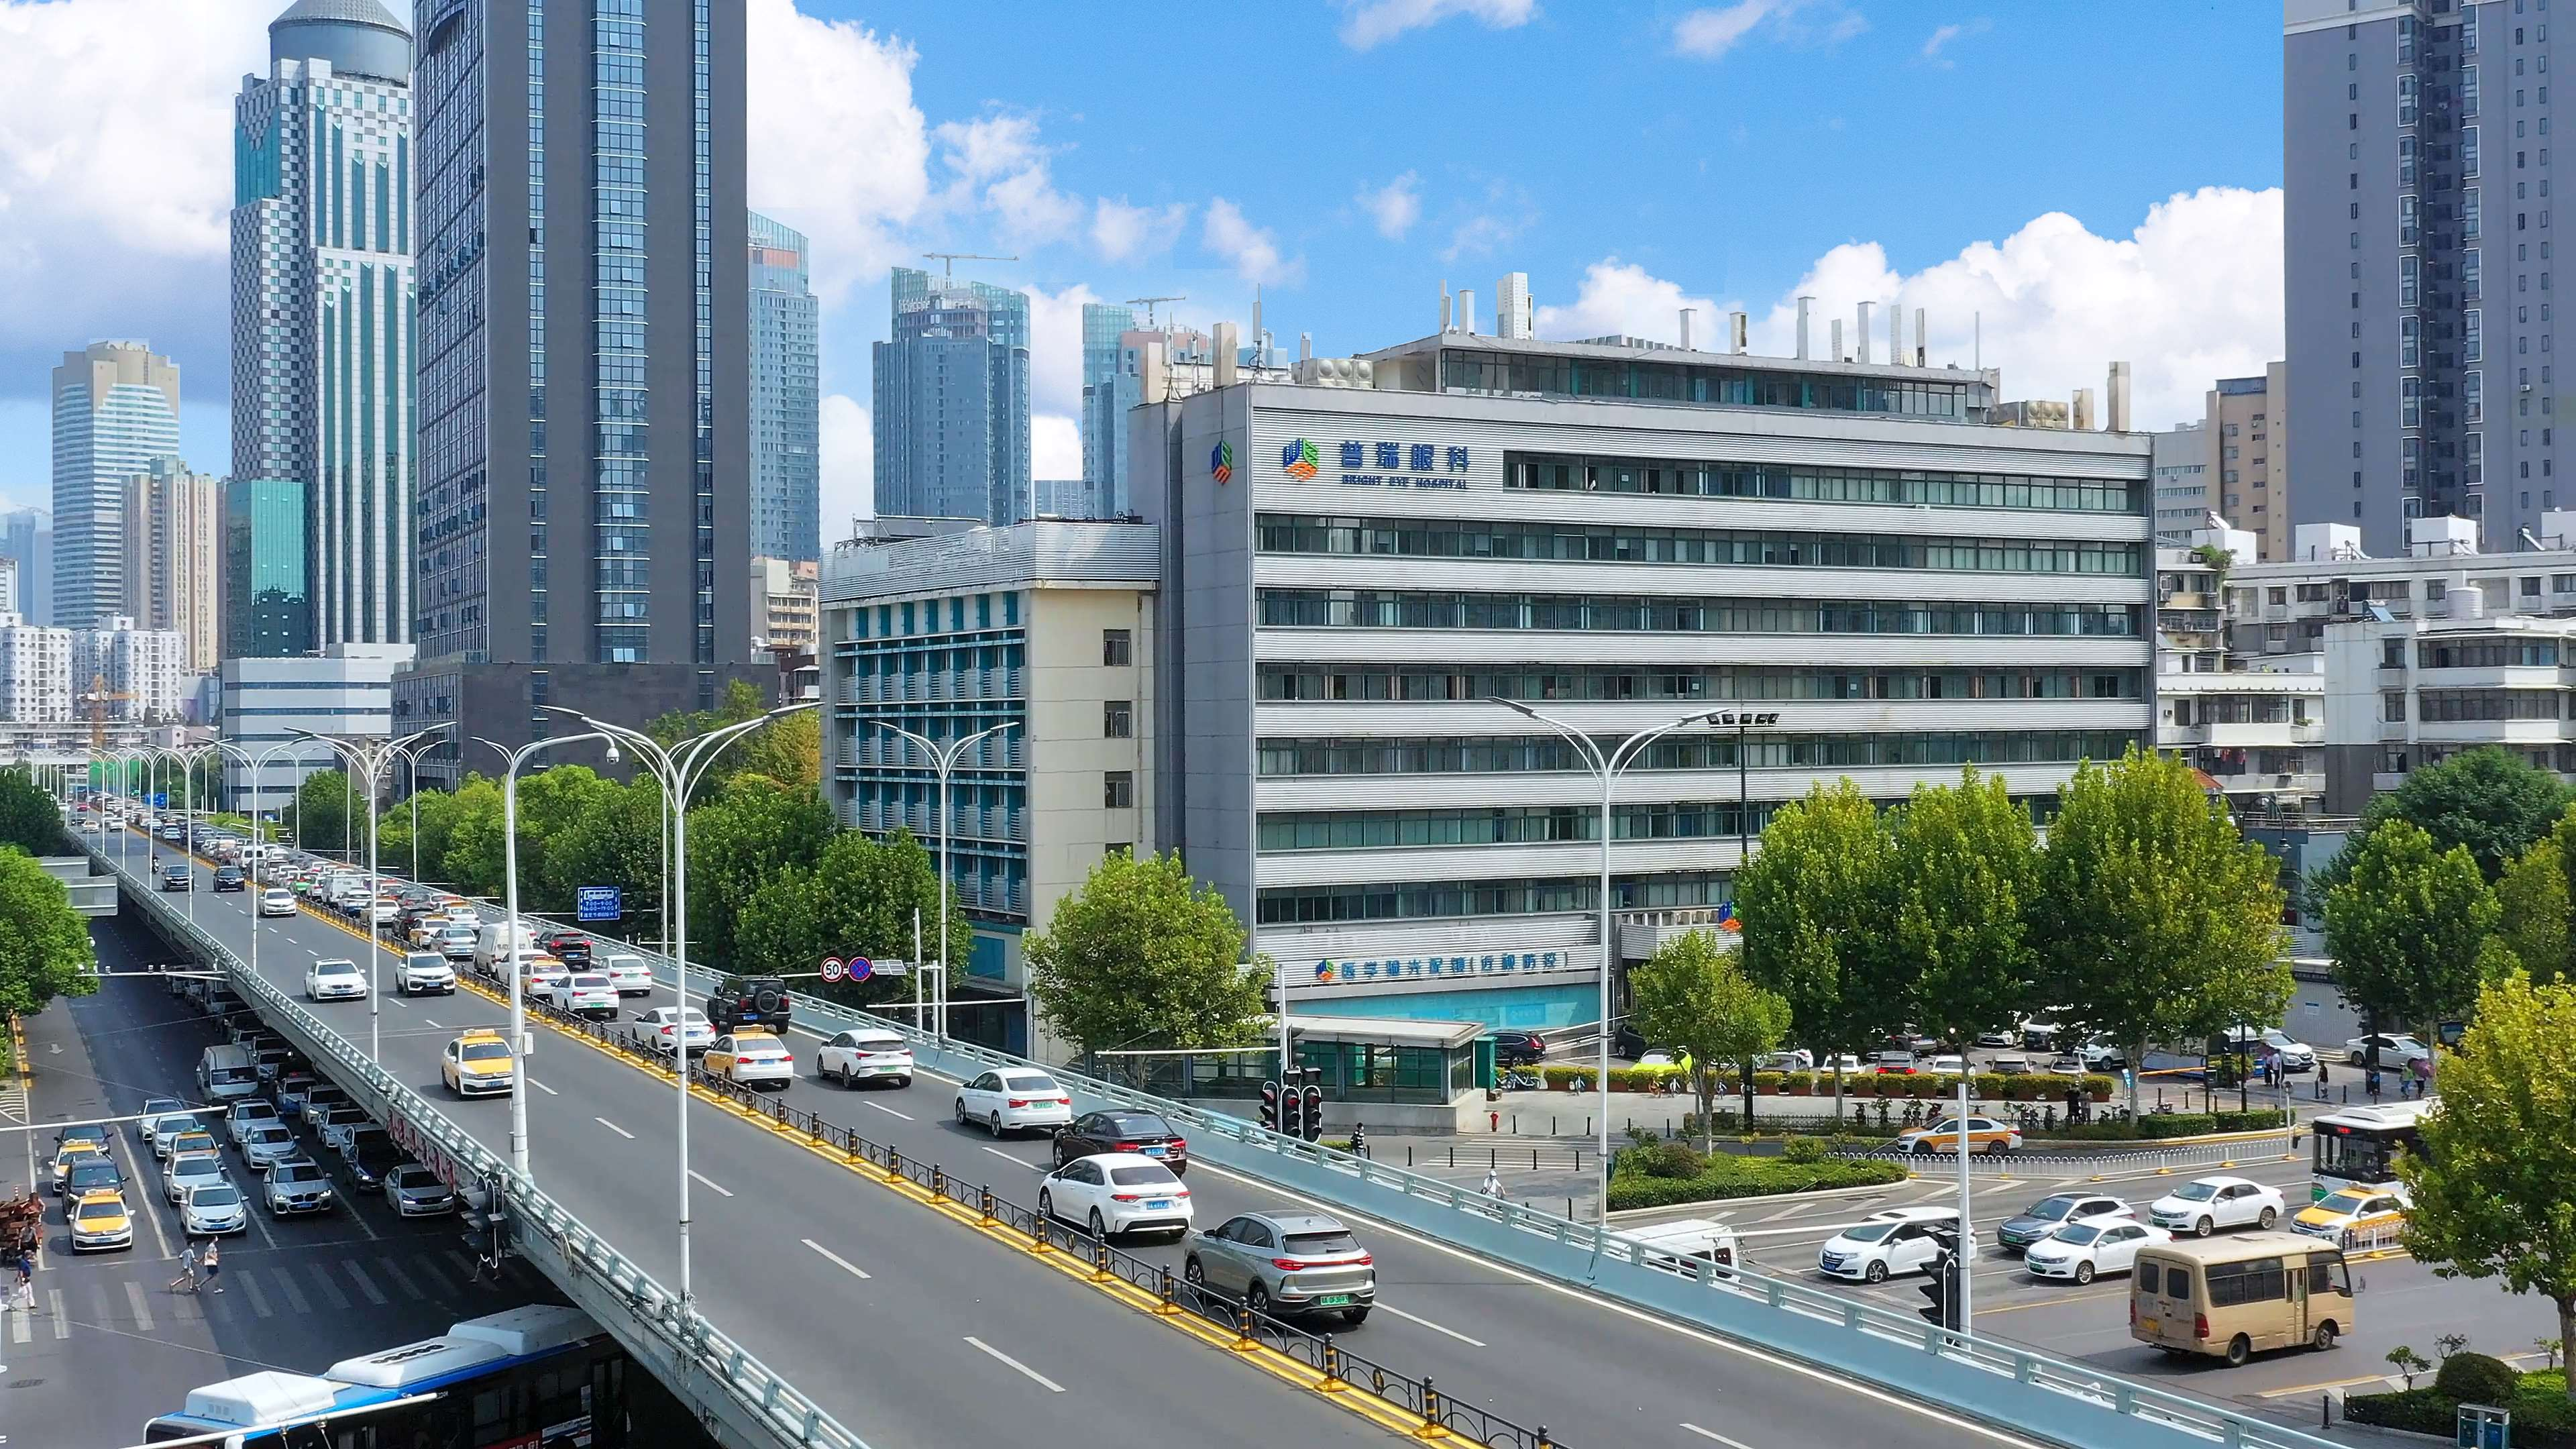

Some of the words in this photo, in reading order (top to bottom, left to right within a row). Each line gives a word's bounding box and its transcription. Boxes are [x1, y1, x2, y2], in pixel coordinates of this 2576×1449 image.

[1340, 440, 1470, 472] 普瑞眼科
[1342, 474, 1382, 486] BRIGHT
[1389, 476, 1409, 487] EYE
[1415, 478, 1470, 490] HOSPITAL
[826, 964, 839, 975] 50
